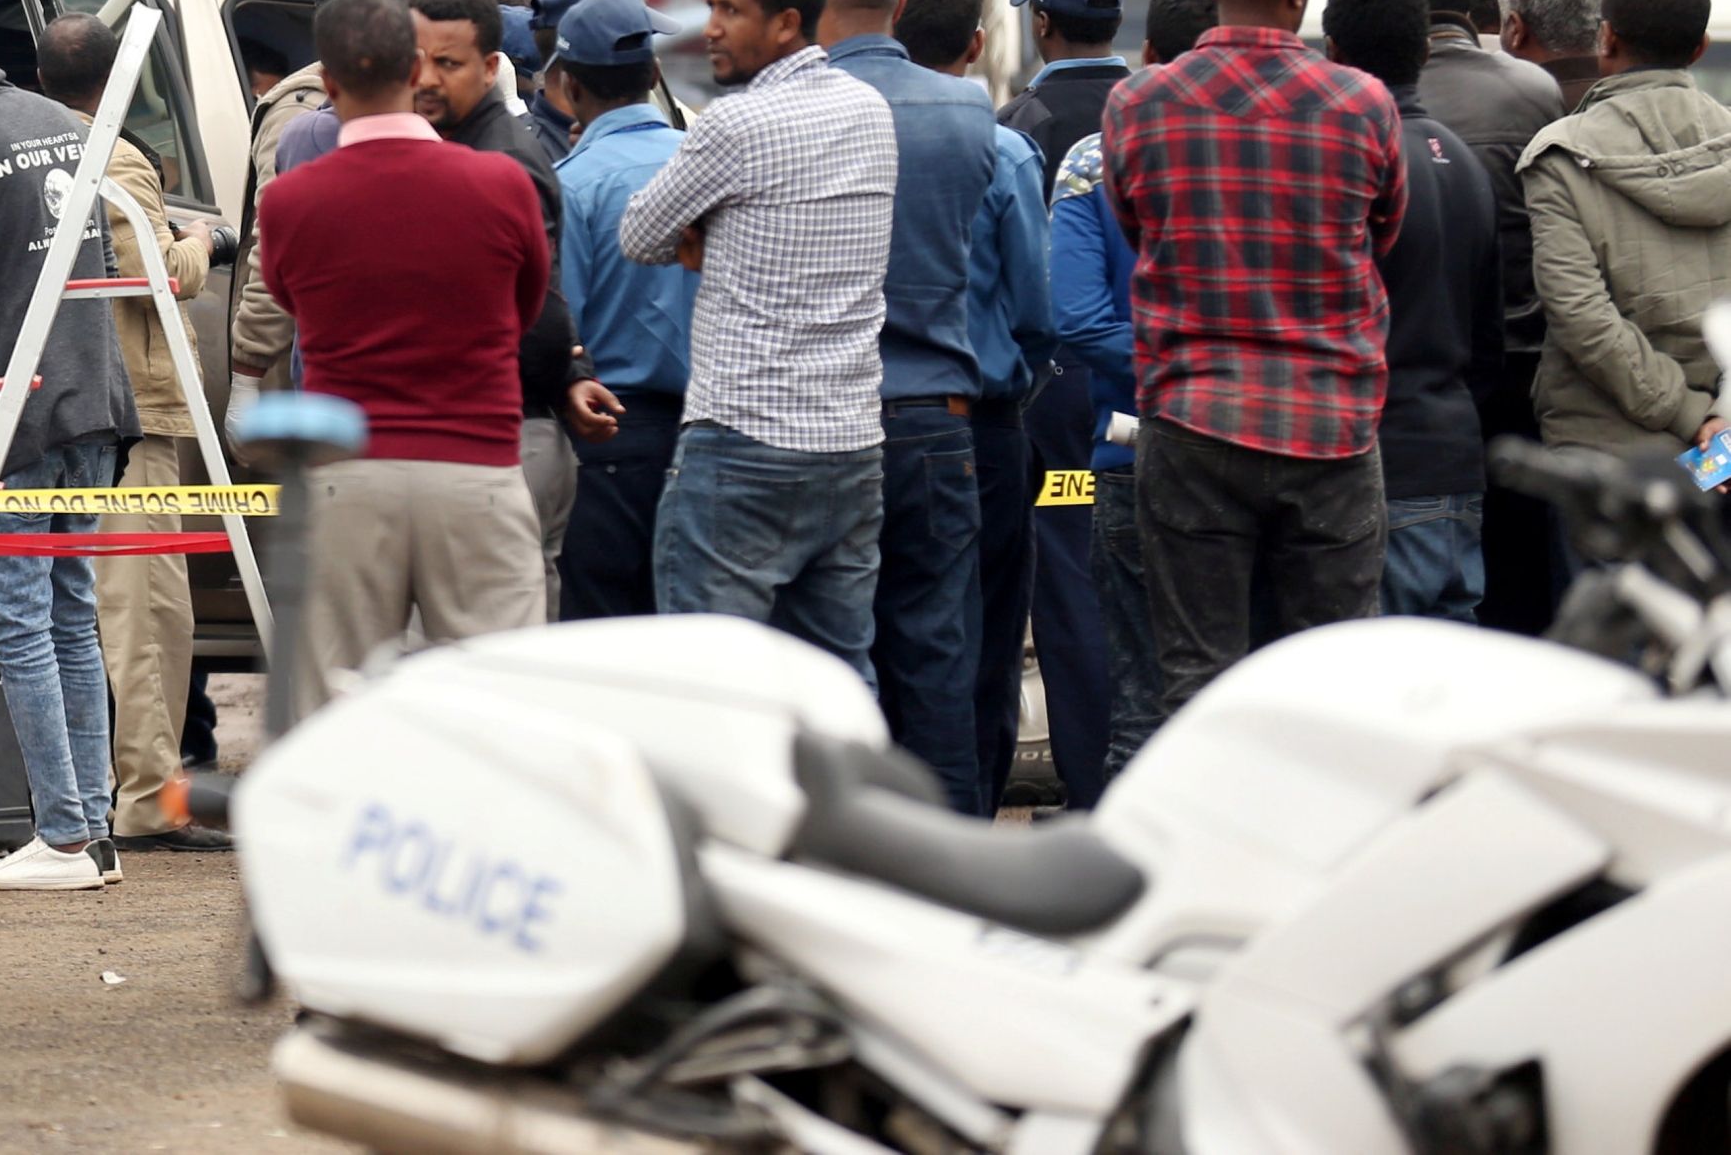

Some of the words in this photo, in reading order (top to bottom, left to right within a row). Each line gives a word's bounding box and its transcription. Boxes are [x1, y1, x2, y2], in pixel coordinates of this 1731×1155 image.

[20, 138, 43, 150] YOUR
[15, 149, 54, 170] OUR
[93, 492, 182, 514] SCENE
[187, 490, 271, 514] CRIME
[339, 802, 564, 955] POLICE
